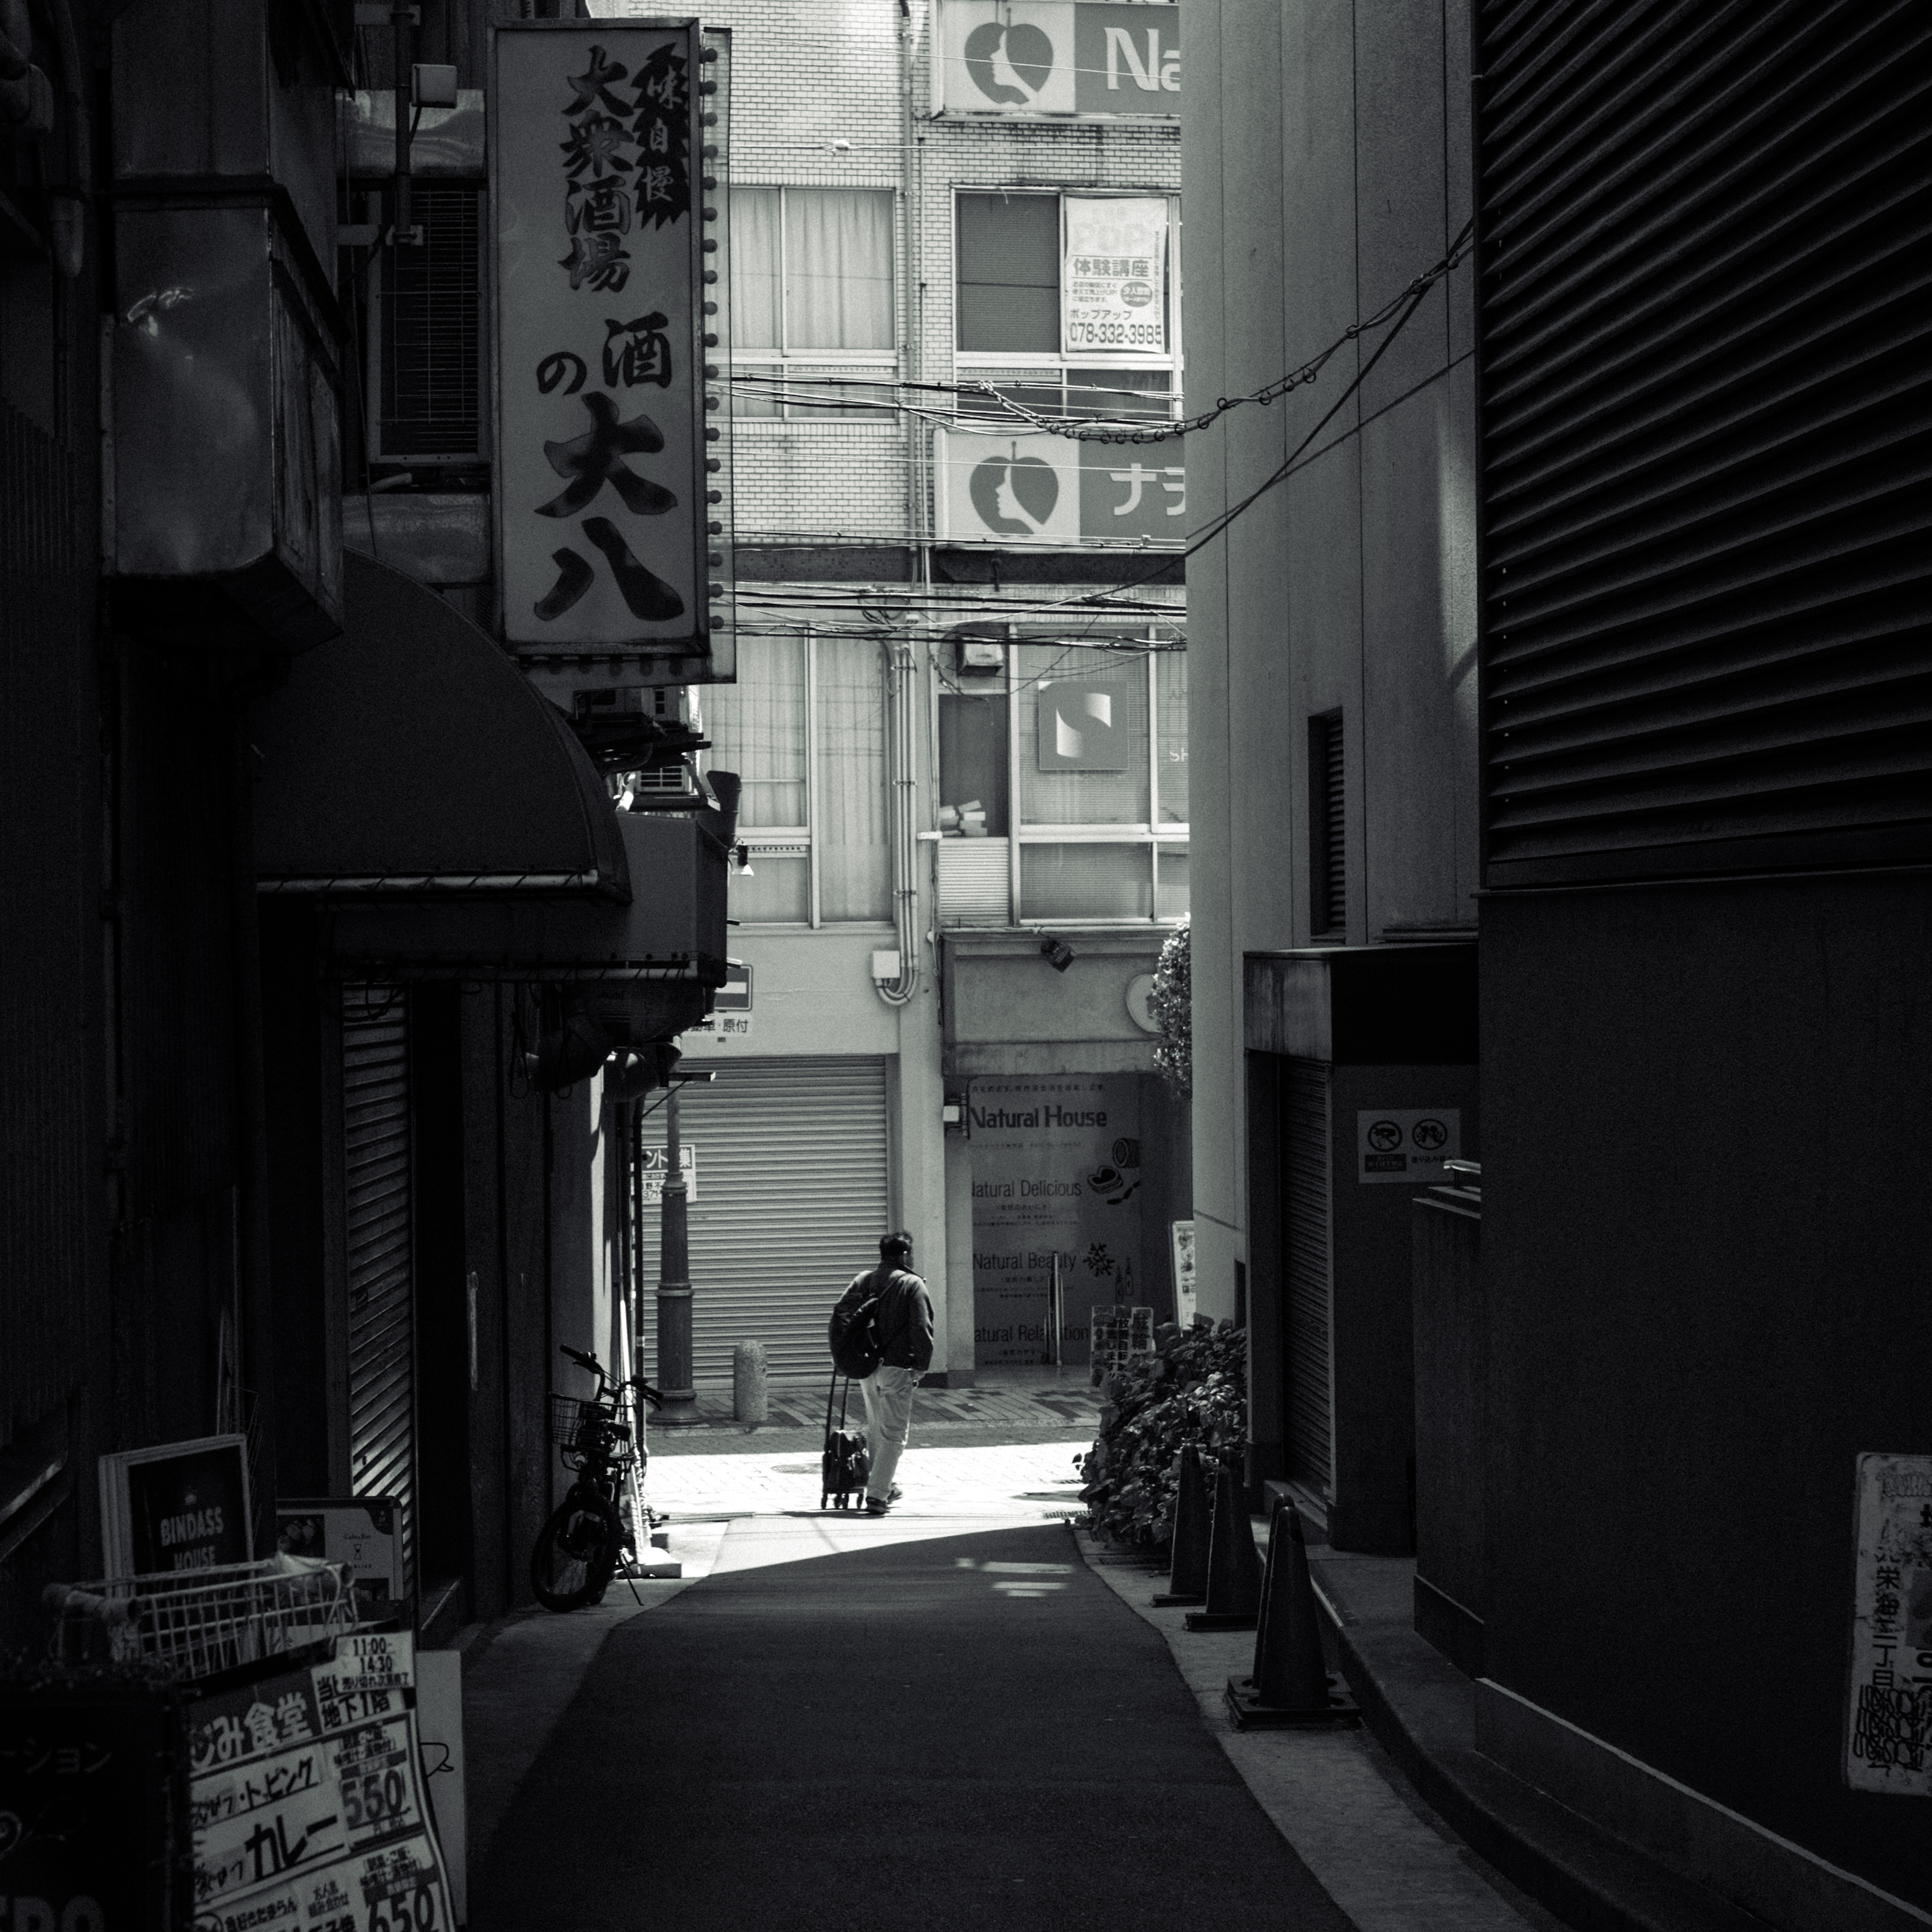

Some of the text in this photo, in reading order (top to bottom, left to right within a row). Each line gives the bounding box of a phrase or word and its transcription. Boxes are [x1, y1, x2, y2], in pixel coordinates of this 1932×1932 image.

[557, 45, 634, 293] 大衆酒場
[1074, 258, 1149, 277] 体験講座
[970, 1105, 1108, 1129] Natural House
[1021, 1180, 1082, 1197] Delicious
[973, 1253, 1022, 1270] Natural
[974, 1326, 1013, 1343] atural
[160, 1506, 225, 1547] BINDASS
[173, 1545, 216, 1570] HOUSE
[342, 1769, 403, 1829] 550
[245, 1814, 338, 1881] カレー
